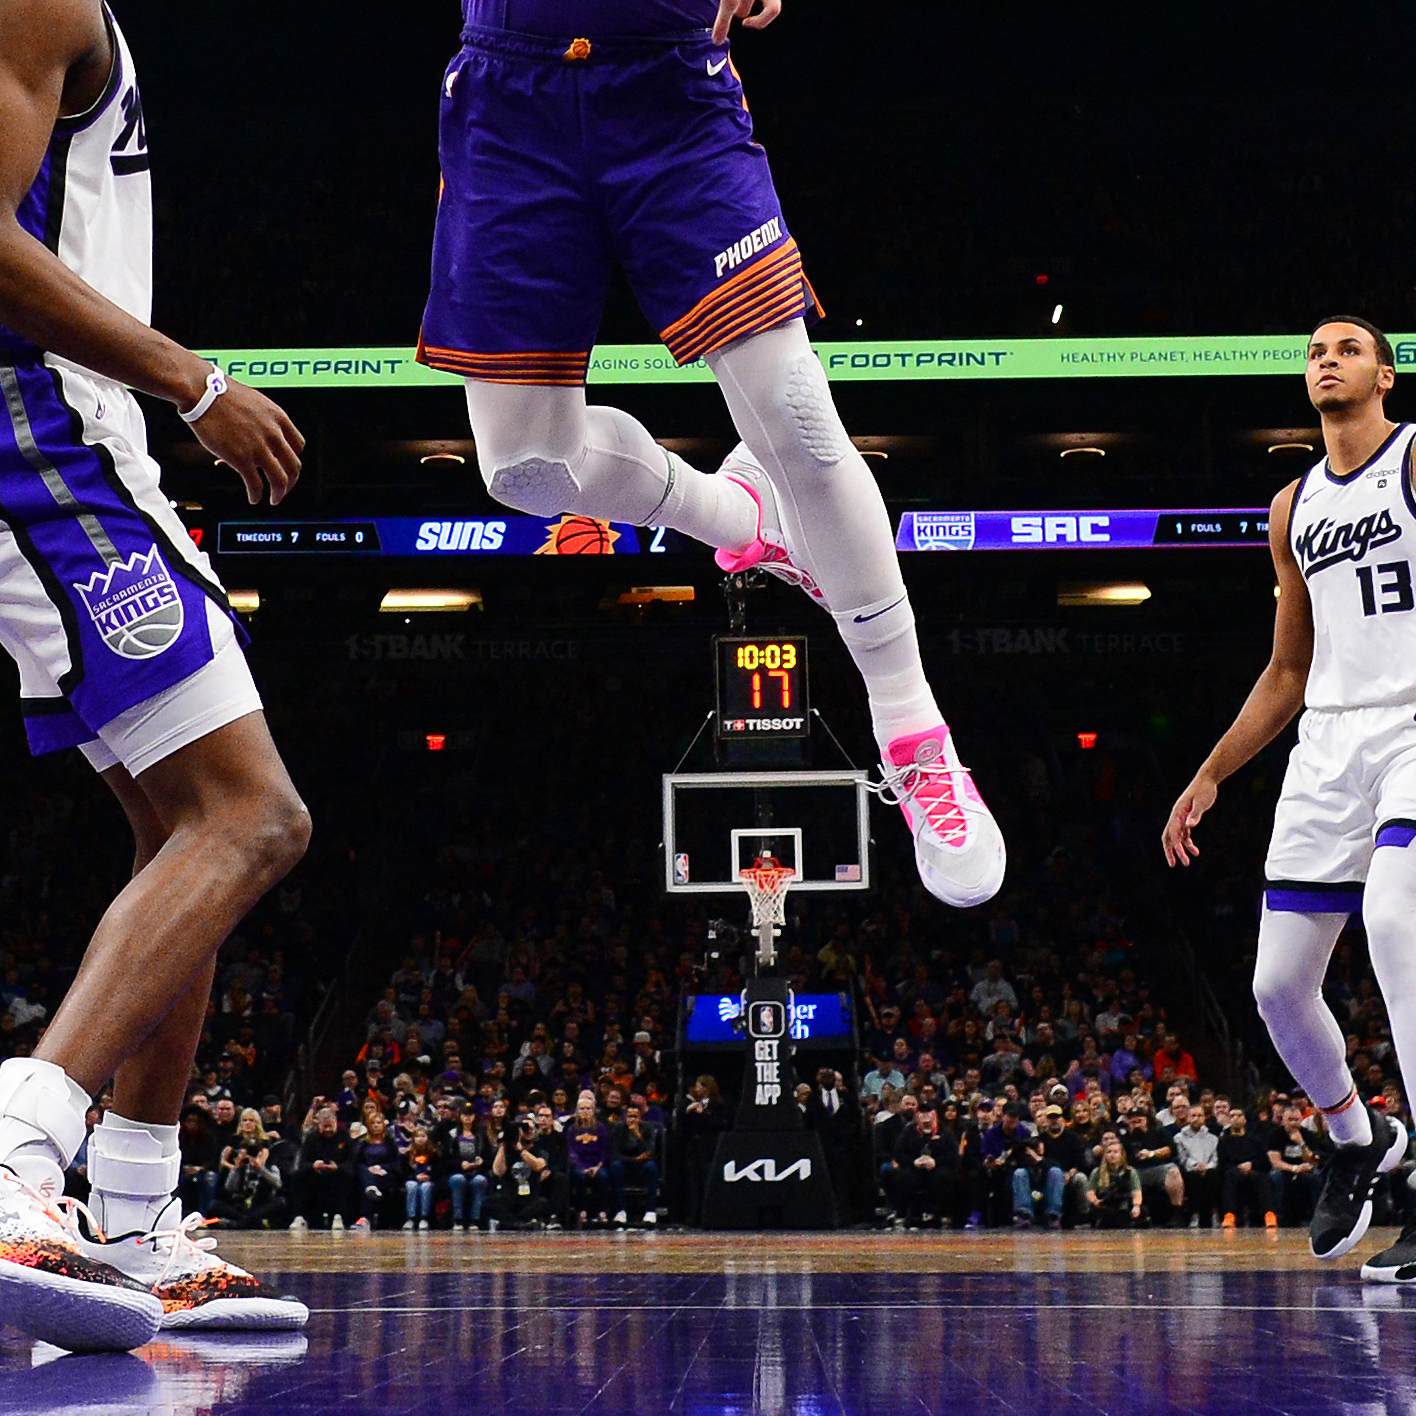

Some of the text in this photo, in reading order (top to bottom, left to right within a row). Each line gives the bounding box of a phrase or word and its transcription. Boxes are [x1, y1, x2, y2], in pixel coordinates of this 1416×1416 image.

[714, 216, 783, 278] PHOENIX
[227, 358, 402, 377] FOOTPRINT
[588, 358, 640, 370] AGING
[829, 351, 1008, 369] FOOTPRINT
[1060, 351, 1128, 364] HEALTHY
[1130, 349, 1188, 364] PLANET,
[1191, 348, 1259, 363] HEALTHY
[290, 531, 299, 543] 7
[355, 531, 364, 543] 0
[415, 520, 507, 551] SUNS
[649, 525, 666, 553] 2
[917, 524, 972, 539] KINGS
[1011, 516, 1111, 543] SAC
[1176, 522, 1183, 535] 1
[1191, 523, 1222, 534] FOULS
[1239, 521, 1248, 534] 7
[1295, 507, 1404, 580] Kings
[92, 573, 166, 614] SACRAMENTO
[1355, 560, 1416, 618] 13
[97, 584, 178, 636] KINGS
[737, 644, 797, 670] 10:03
[752, 671, 791, 709] 17
[745, 717, 805, 731] TISSOT
[754, 1040, 780, 1061] GET
[755, 1062, 781, 1083] THE
[754, 1084, 782, 1106] APP
[723, 1158, 812, 1182] KIA
